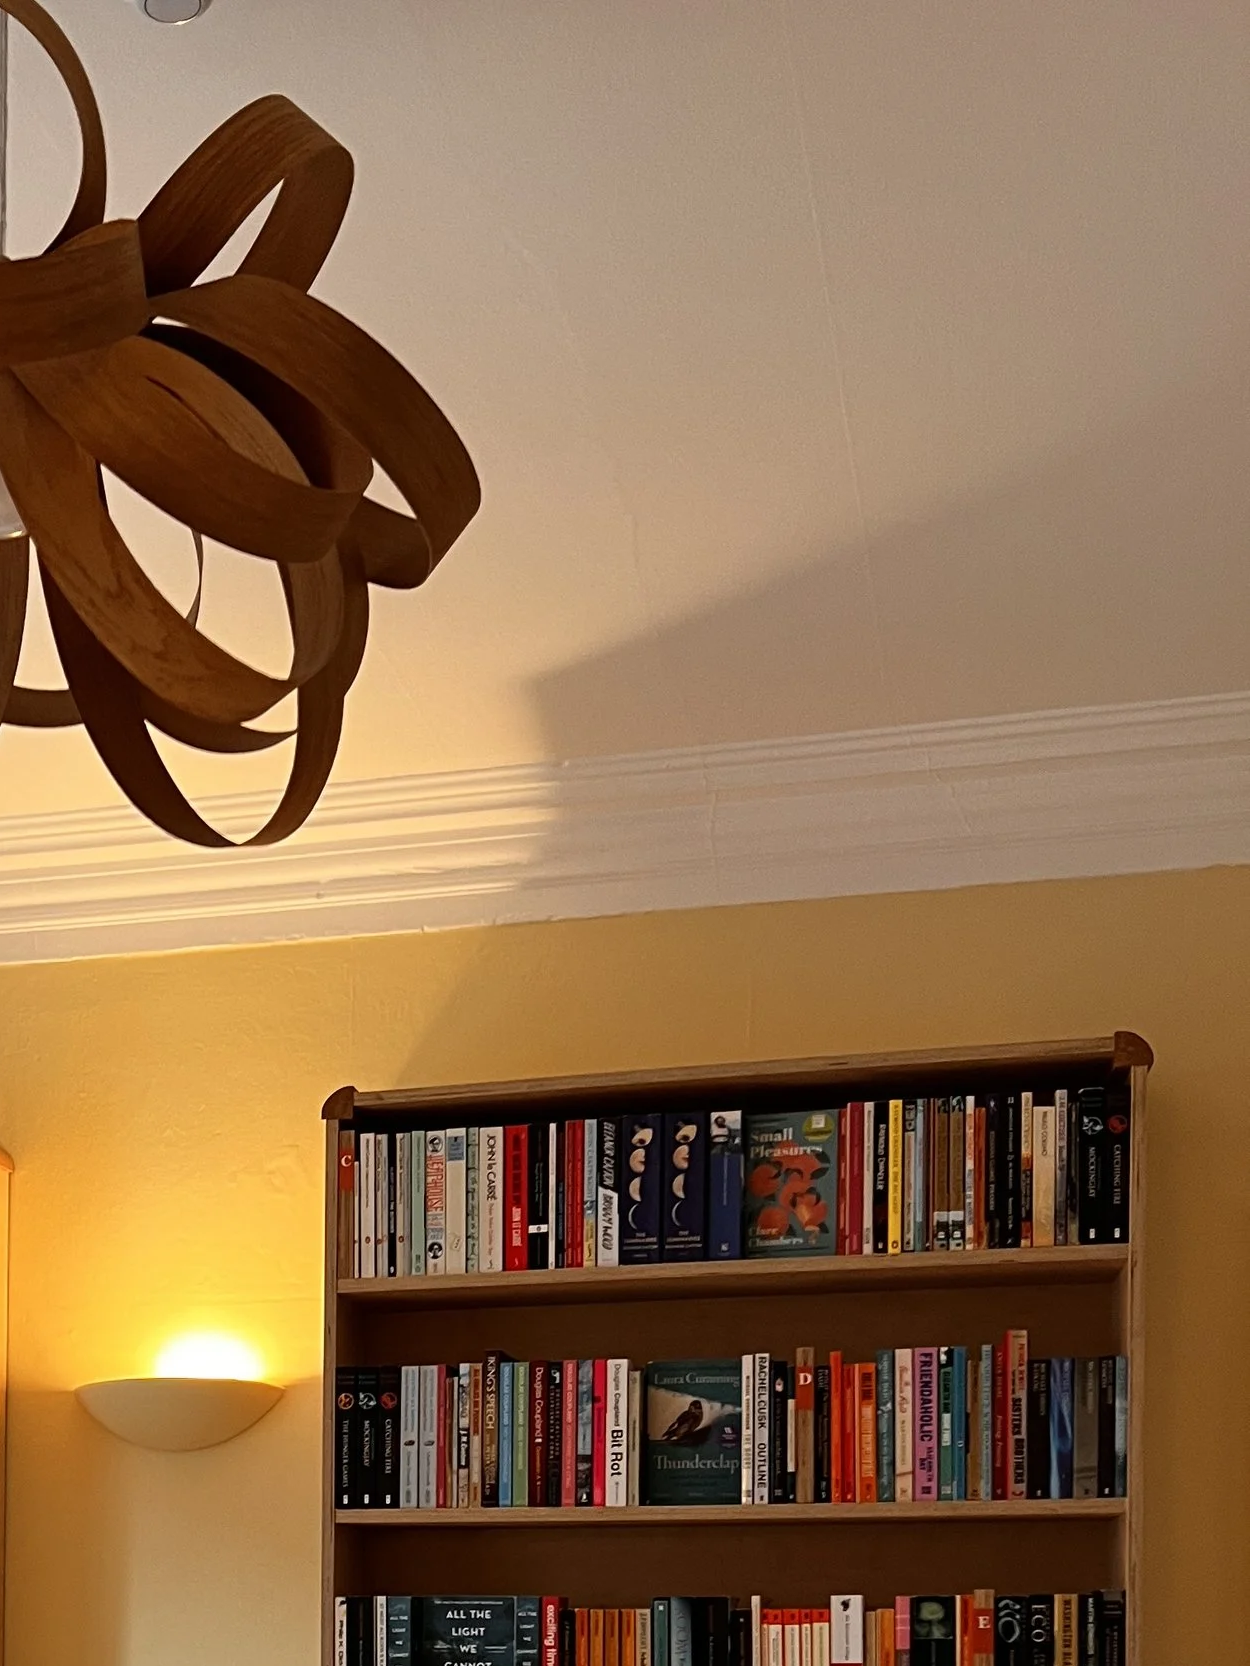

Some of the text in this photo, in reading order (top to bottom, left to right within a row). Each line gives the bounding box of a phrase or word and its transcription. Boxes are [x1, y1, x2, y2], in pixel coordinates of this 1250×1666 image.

[749, 1145, 823, 1158] Pleasures
[752, 1127, 794, 1142] Small
[342, 1155, 352, 1167] C
[1088, 1147, 1096, 1199] MOCKINGJAY
[1112, 1144, 1121, 1186] CATCHING
[654, 1373, 740, 1388] Laura Cumming
[757, 1356, 767, 1430] RACHEL CUSK
[799, 1373, 811, 1385] D
[919, 1352, 933, 1443] FRIENDAHOLIC
[486, 1394, 496, 1429] SPEECH
[534, 1367, 544, 1437] Douglas Coupland
[613, 1393, 621, 1427] Coupland
[1012, 1397, 1022, 1436] SISTERS
[363, 1420, 371, 1467] MOCKINGJAY
[611, 1429, 623, 1476] Bit Rot
[1014, 1438, 1025, 1484] BROTHERS
[653, 1454, 740, 1475] Thunderclap
[757, 1442, 767, 1489] OUTLINE
[446, 1610, 492, 1619] ALL THE
[451, 1627, 486, 1637] LIGHT
[545, 1605, 557, 1646] exciting
[978, 1616, 990, 1628] E
[1061, 1598, 1072, 1648] WASHINGTON
[459, 1644, 478, 1654] WE
